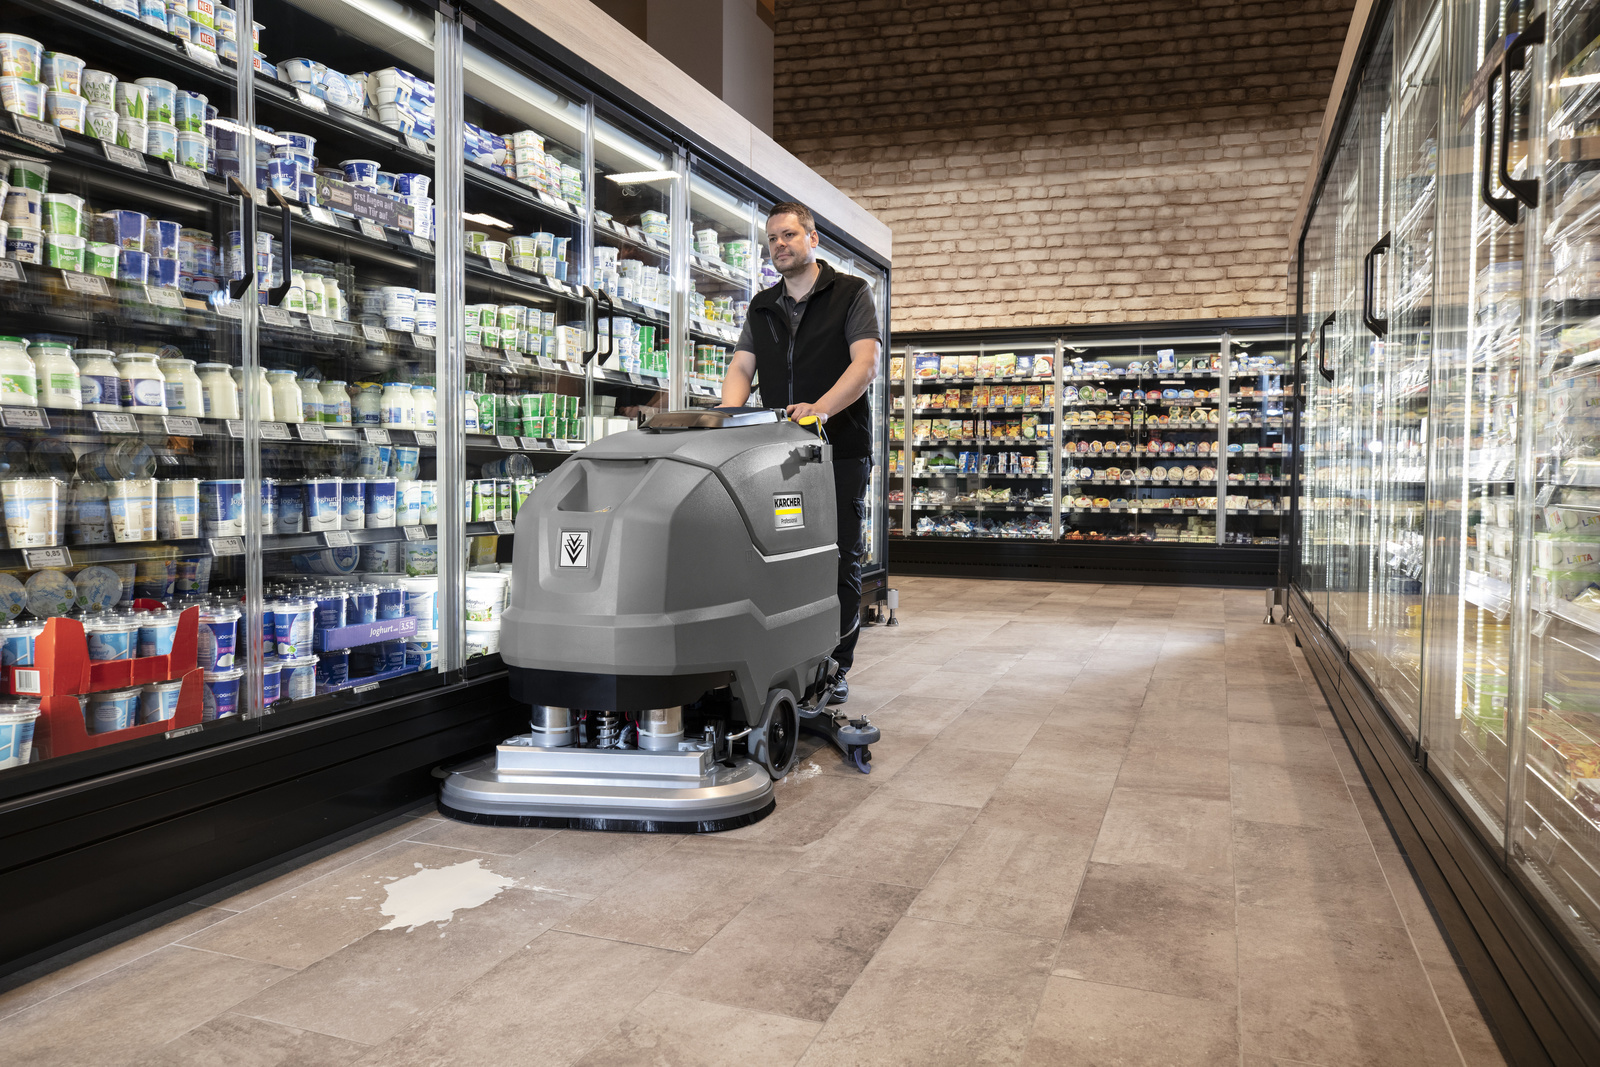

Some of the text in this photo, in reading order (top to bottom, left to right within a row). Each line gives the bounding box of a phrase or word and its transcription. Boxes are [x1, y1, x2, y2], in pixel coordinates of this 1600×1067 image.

[199, 0, 213, 15] NEU
[201, 33, 215, 47] NEU
[85, 81, 110, 91] ALOE
[93, 118, 113, 128] ALO
[353, 190, 366, 202] Erst
[64, 248, 75, 256] Bio
[1581, 515, 1600, 527] LÄTT
[369, 624, 394, 638] Joghurt
